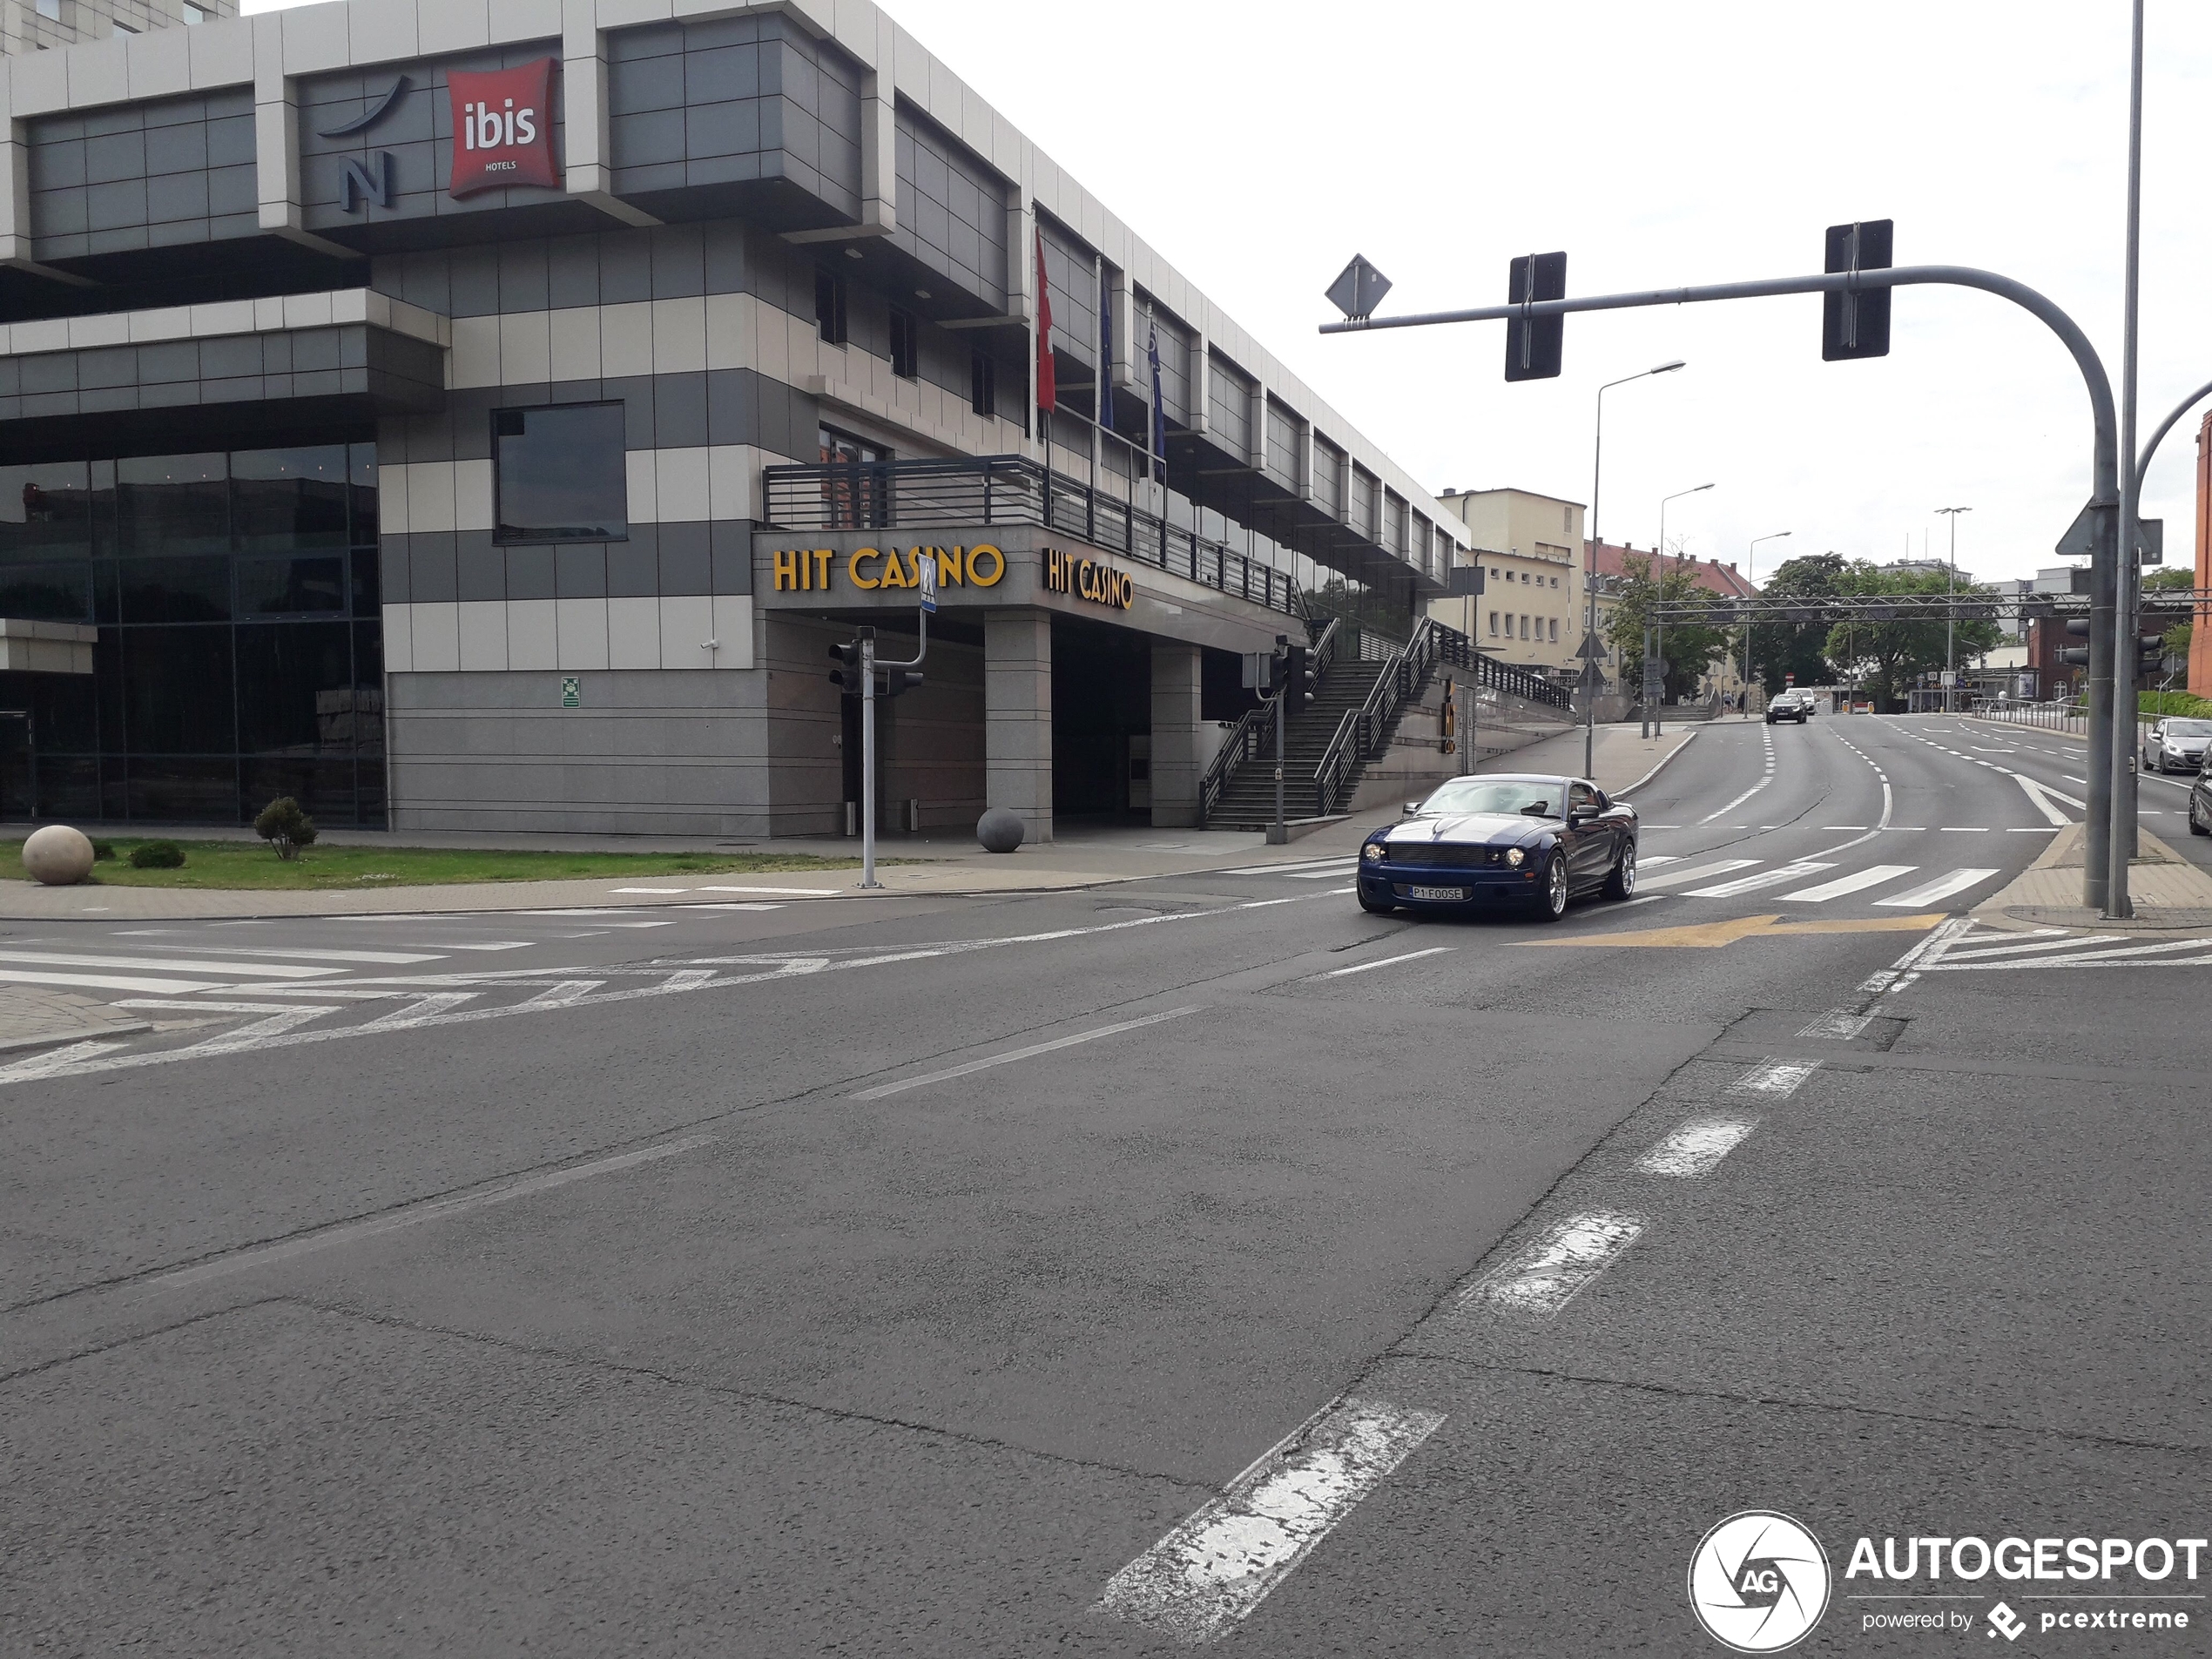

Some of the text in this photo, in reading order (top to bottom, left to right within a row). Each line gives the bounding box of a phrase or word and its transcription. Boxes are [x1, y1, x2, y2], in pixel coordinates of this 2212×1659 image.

[465, 98, 536, 151] ibis
[485, 160, 516, 172] HOTELS
[773, 543, 1005, 590] HIT CASNO
[1047, 548, 1133, 610] HIT CASINO
